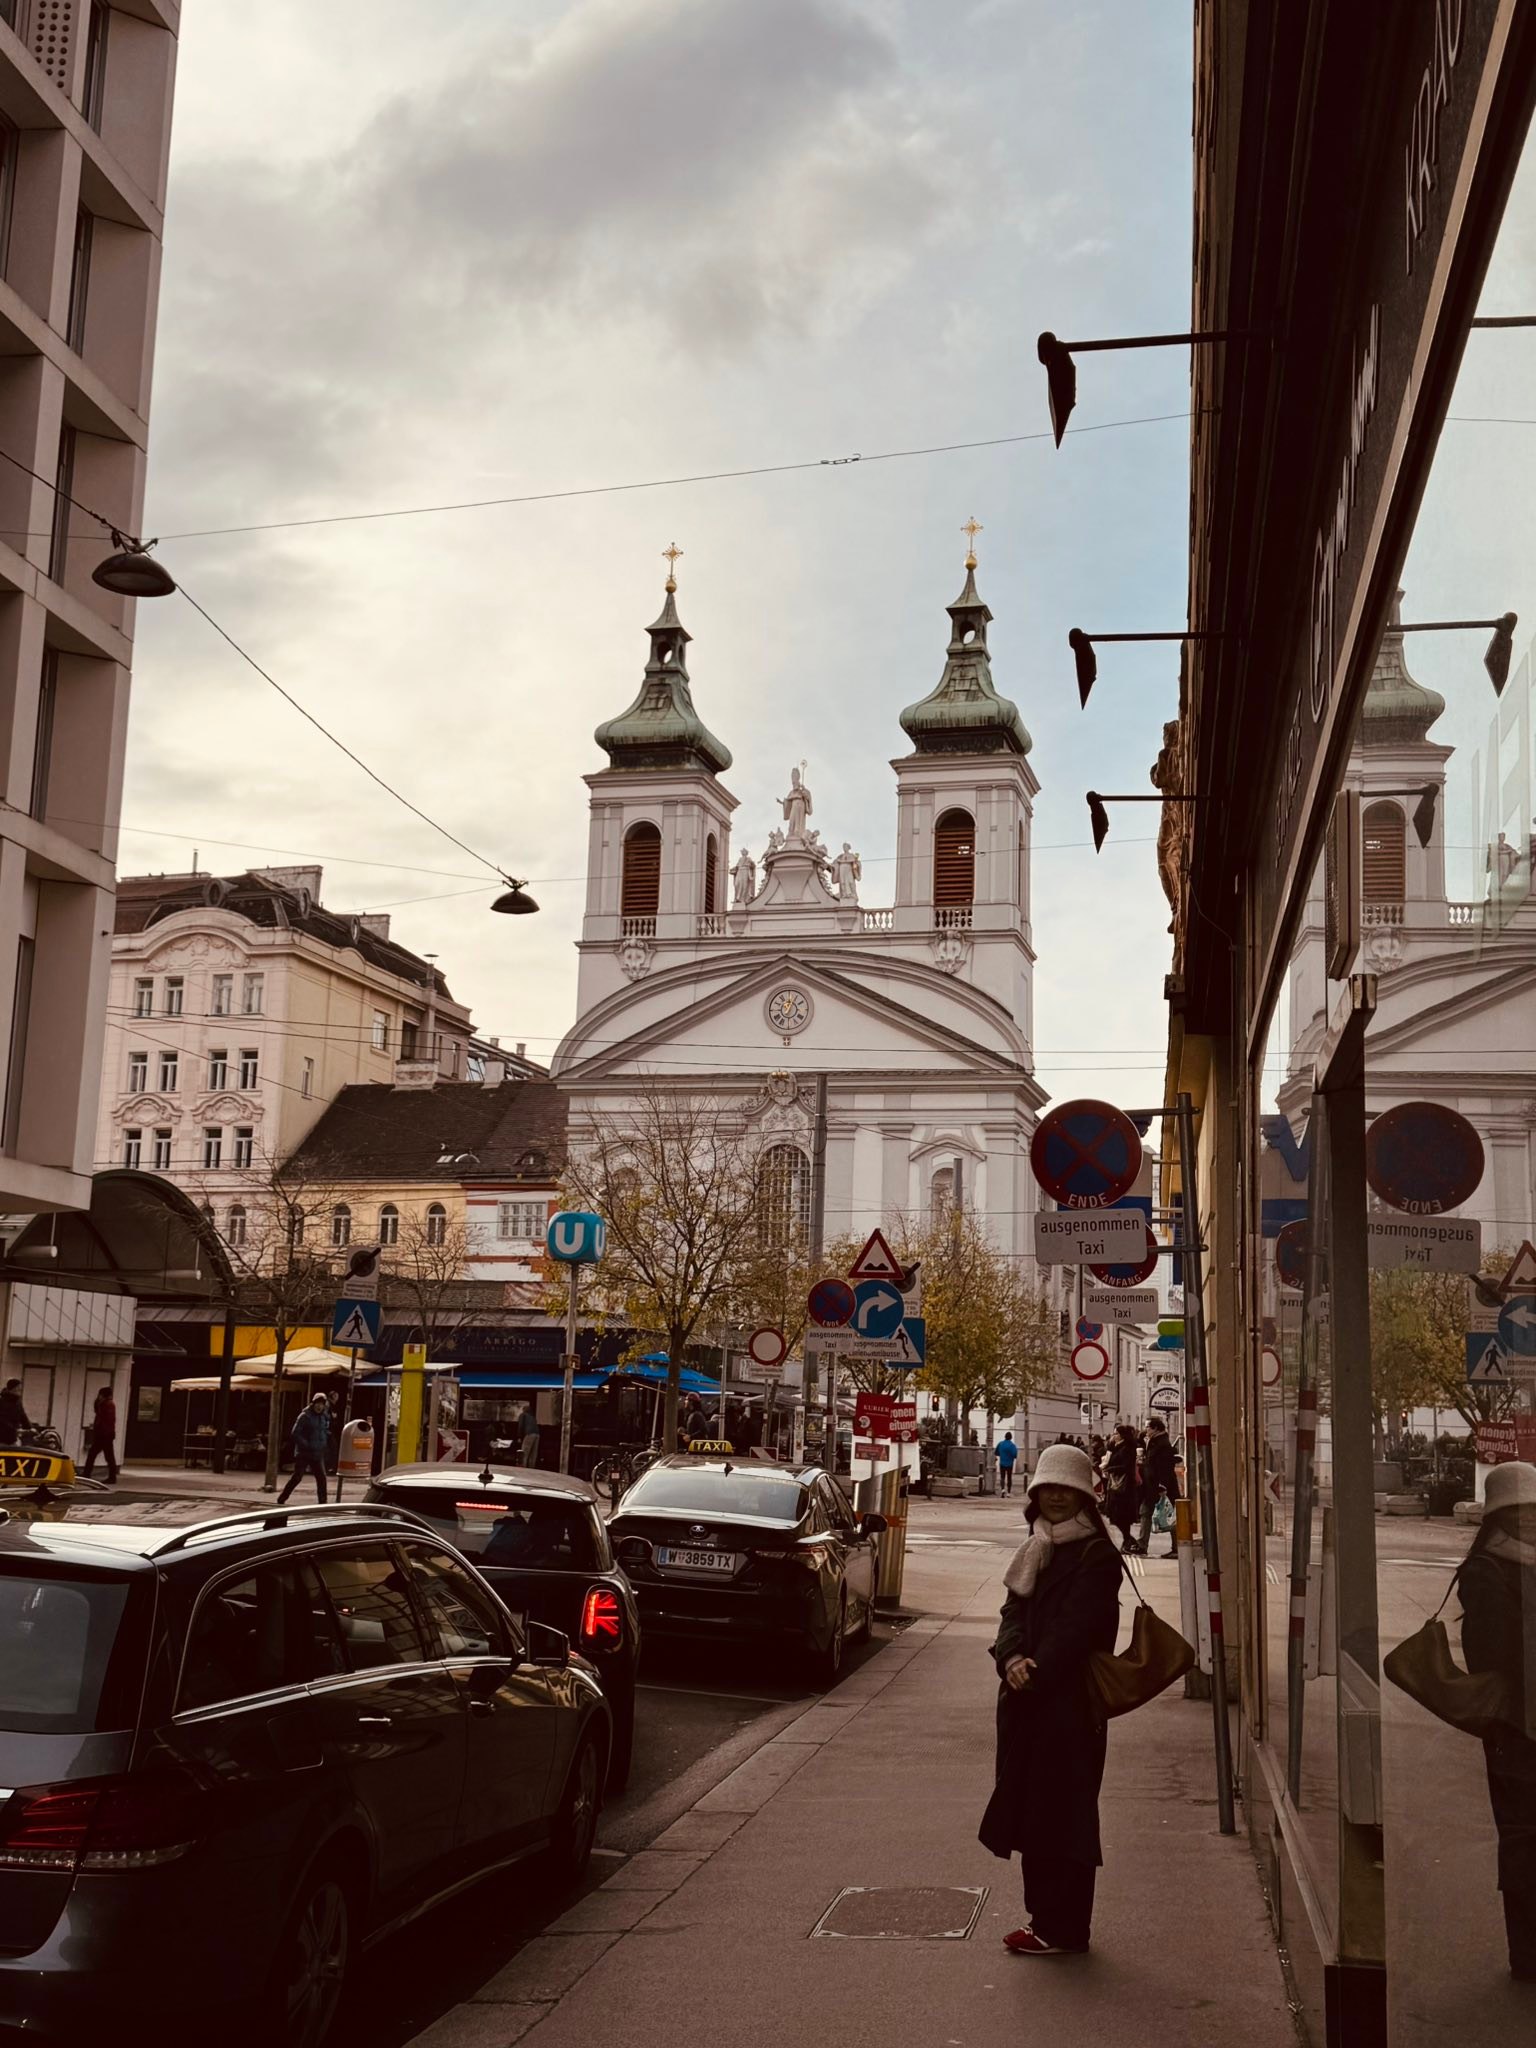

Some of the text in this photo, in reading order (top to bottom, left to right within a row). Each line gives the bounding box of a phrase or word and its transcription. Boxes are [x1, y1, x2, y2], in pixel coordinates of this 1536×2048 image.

[1067, 1192, 1109, 1208] ENDE
[1040, 1218, 1140, 1236] ausgenommen
[555, 1222, 585, 1255] U
[1076, 1239, 1105, 1256] Taxi
[1102, 1274, 1142, 1287] ANFANG
[1089, 1293, 1155, 1305] ausgenommen
[1112, 1307, 1132, 1319] Taxi
[821, 1319, 840, 1327] ENDE
[809, 1331, 853, 1339] ausgenommen
[863, 1404, 890, 1413] KURIER
[890, 1407, 915, 1418] ronen
[889, 1419, 917, 1431] eitung
[695, 1441, 726, 1452] TAXI
[668, 1550, 677, 1563] W
[685, 1551, 715, 1566] 3859
